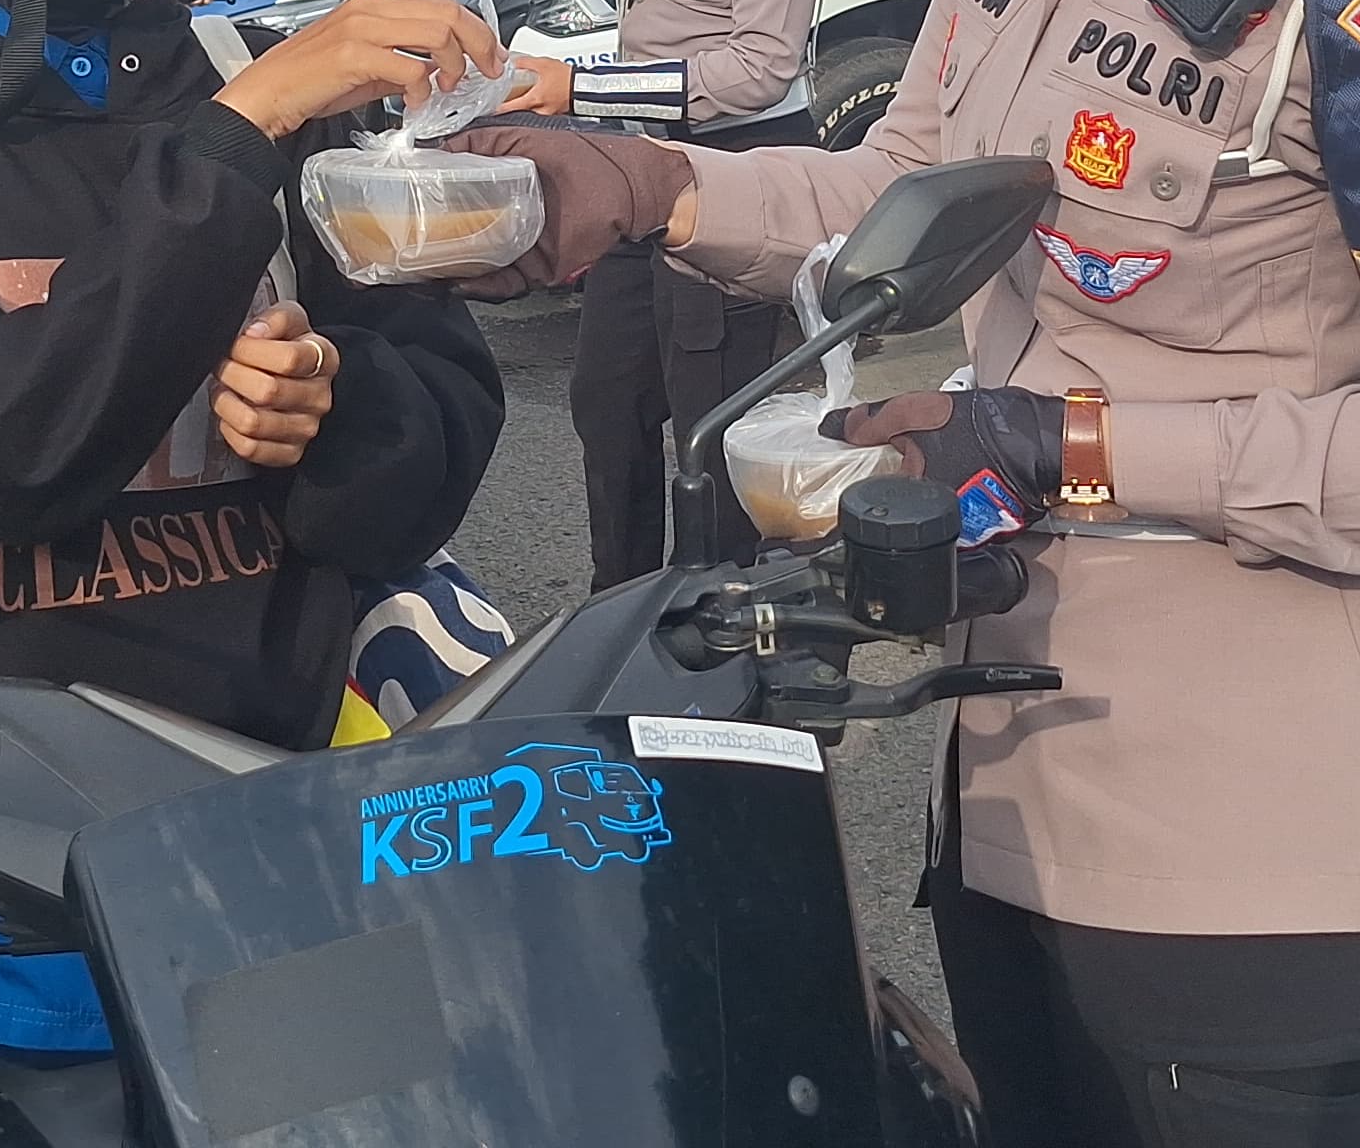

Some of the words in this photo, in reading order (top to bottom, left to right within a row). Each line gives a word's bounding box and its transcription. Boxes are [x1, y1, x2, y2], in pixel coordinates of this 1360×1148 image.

[1068, 18, 1225, 124] POLRI
[360, 774, 492, 819] ANNIVERSARRY
[361, 764, 549, 885] KSF2
